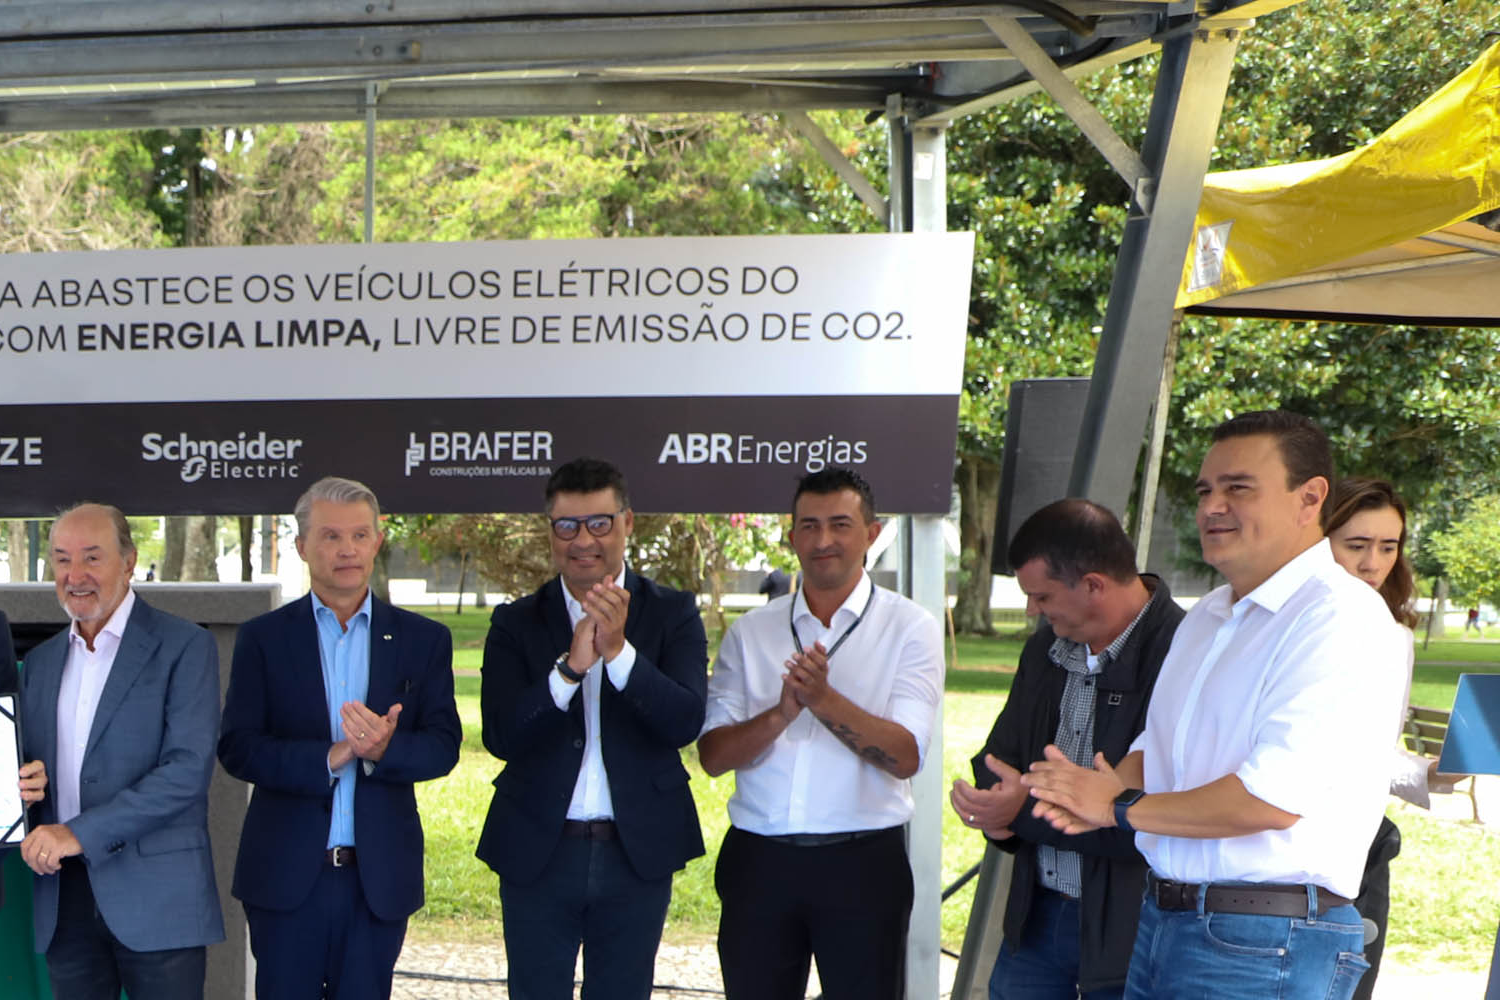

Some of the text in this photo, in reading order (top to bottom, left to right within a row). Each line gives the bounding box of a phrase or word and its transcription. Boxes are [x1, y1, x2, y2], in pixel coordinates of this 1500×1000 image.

[32, 276, 233, 309] ABASTECE
[243, 274, 294, 303] OS
[305, 264, 501, 302] VEÍCULOS
[513, 261, 729, 299] ELÉTRICOS
[741, 266, 799, 295] DO
[78, 321, 245, 351] ENERGIA
[255, 319, 380, 353] LIMPA,
[394, 316, 500, 346] LIVRE
[512, 316, 561, 344] DE
[573, 302, 749, 343] EMISSÃO
[761, 313, 812, 341] DE
[822, 312, 911, 341] CO2.
[142, 431, 303, 461] Schneider
[430, 432, 553, 461] BRAFER
[211, 461, 299, 479] Electric
[429, 465, 490, 477] CONSTRUÇÕES
[492, 465, 536, 476] METÁLICAS
